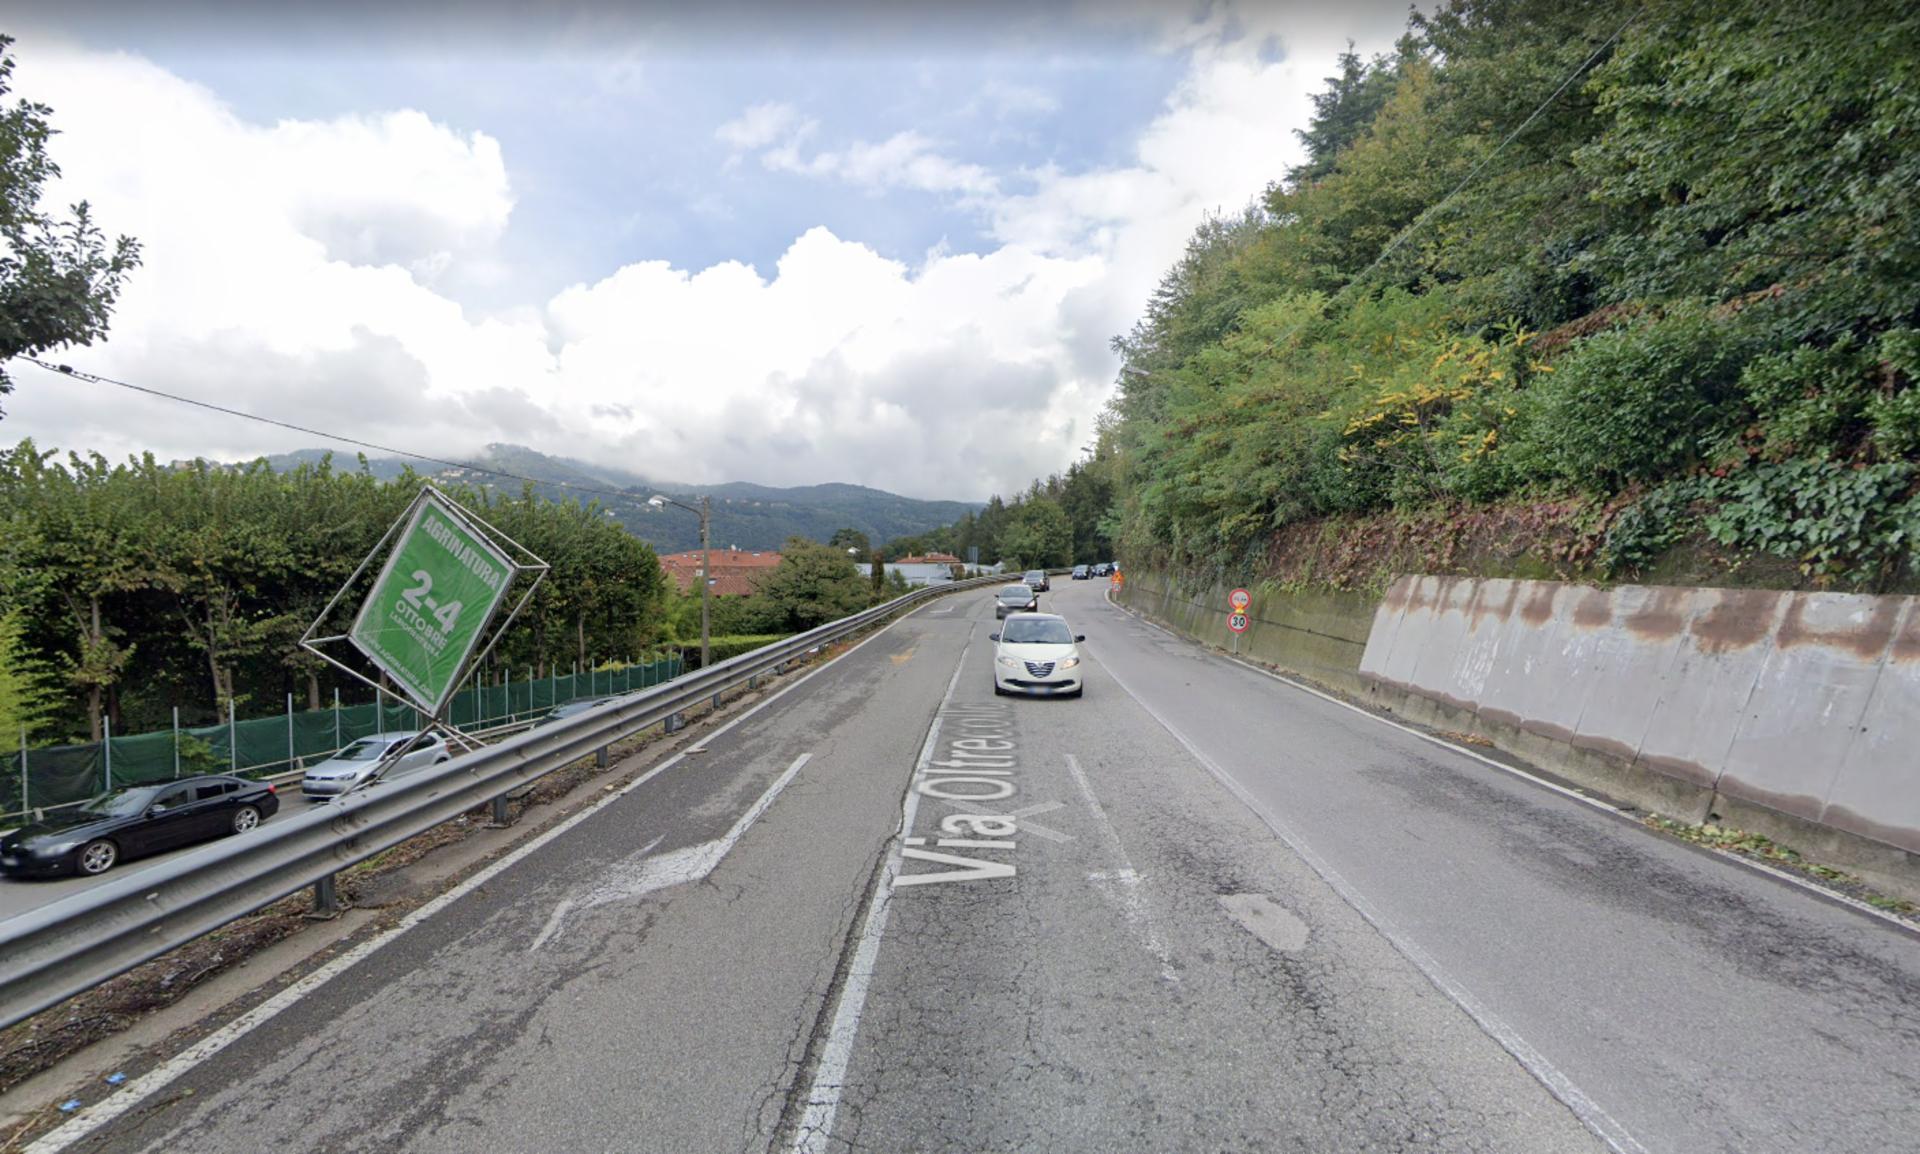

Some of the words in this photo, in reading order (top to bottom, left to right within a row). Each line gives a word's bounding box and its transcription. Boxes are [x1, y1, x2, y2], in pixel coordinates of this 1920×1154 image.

[421, 515, 501, 591] AGRINATURA
[395, 600, 448, 651] OTTOBRE
[402, 570, 463, 634] 2-4
[1232, 616, 1246, 627] 30
